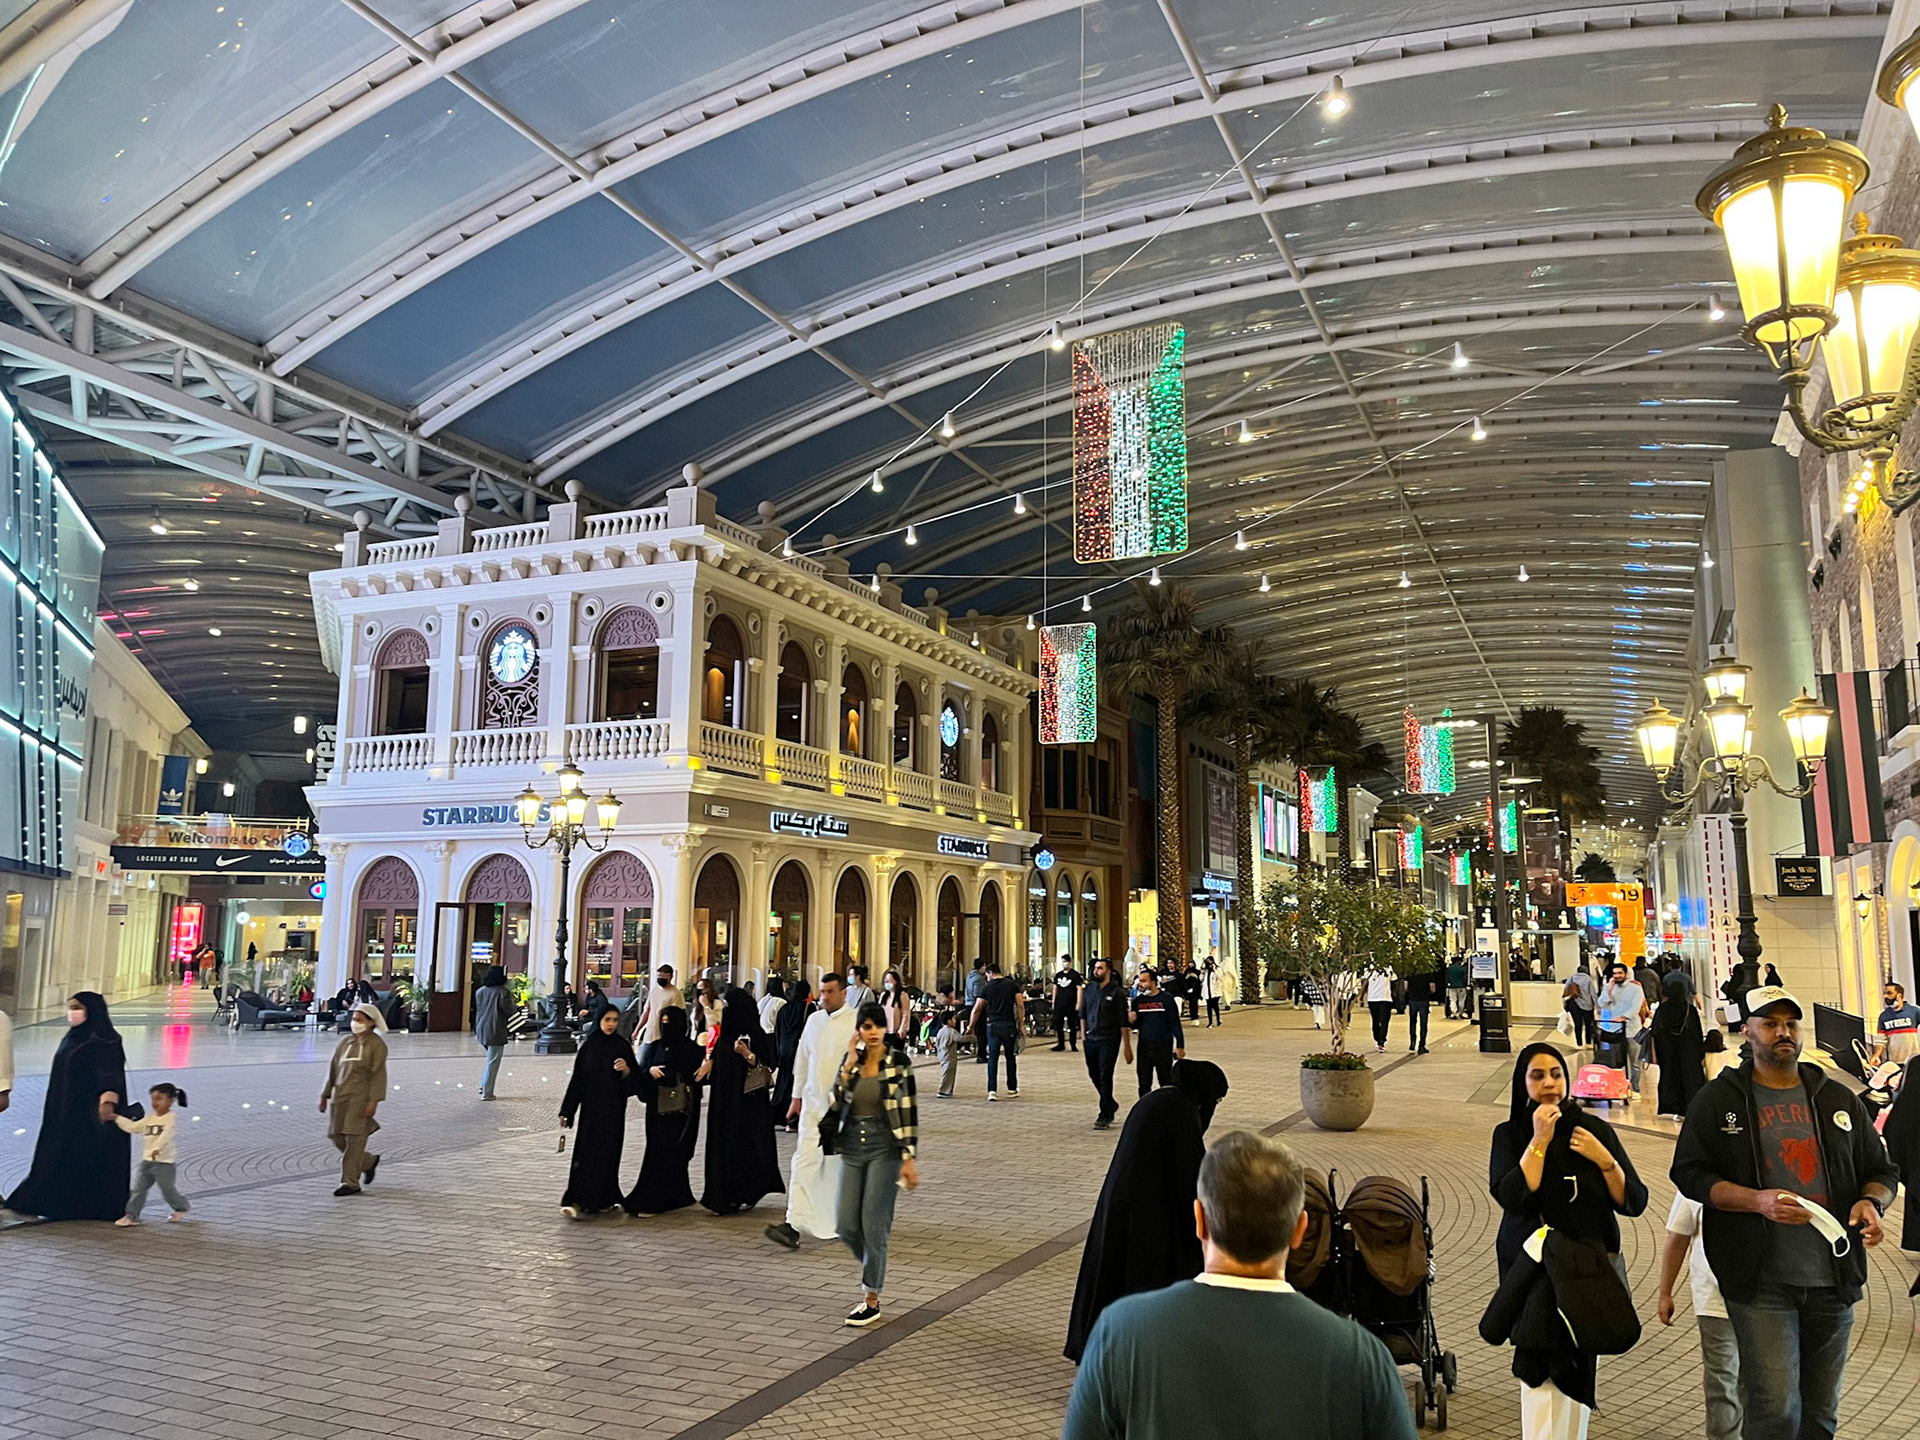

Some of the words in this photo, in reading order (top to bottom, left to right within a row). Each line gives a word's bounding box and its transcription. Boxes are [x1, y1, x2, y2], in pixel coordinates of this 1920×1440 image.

[422, 802, 552, 826] STARBUCS
[168, 832, 237, 845] Welcome
[243, 834, 258, 845] to
[1781, 866, 1797, 875] Jack
[1619, 888, 1640, 902] 19
